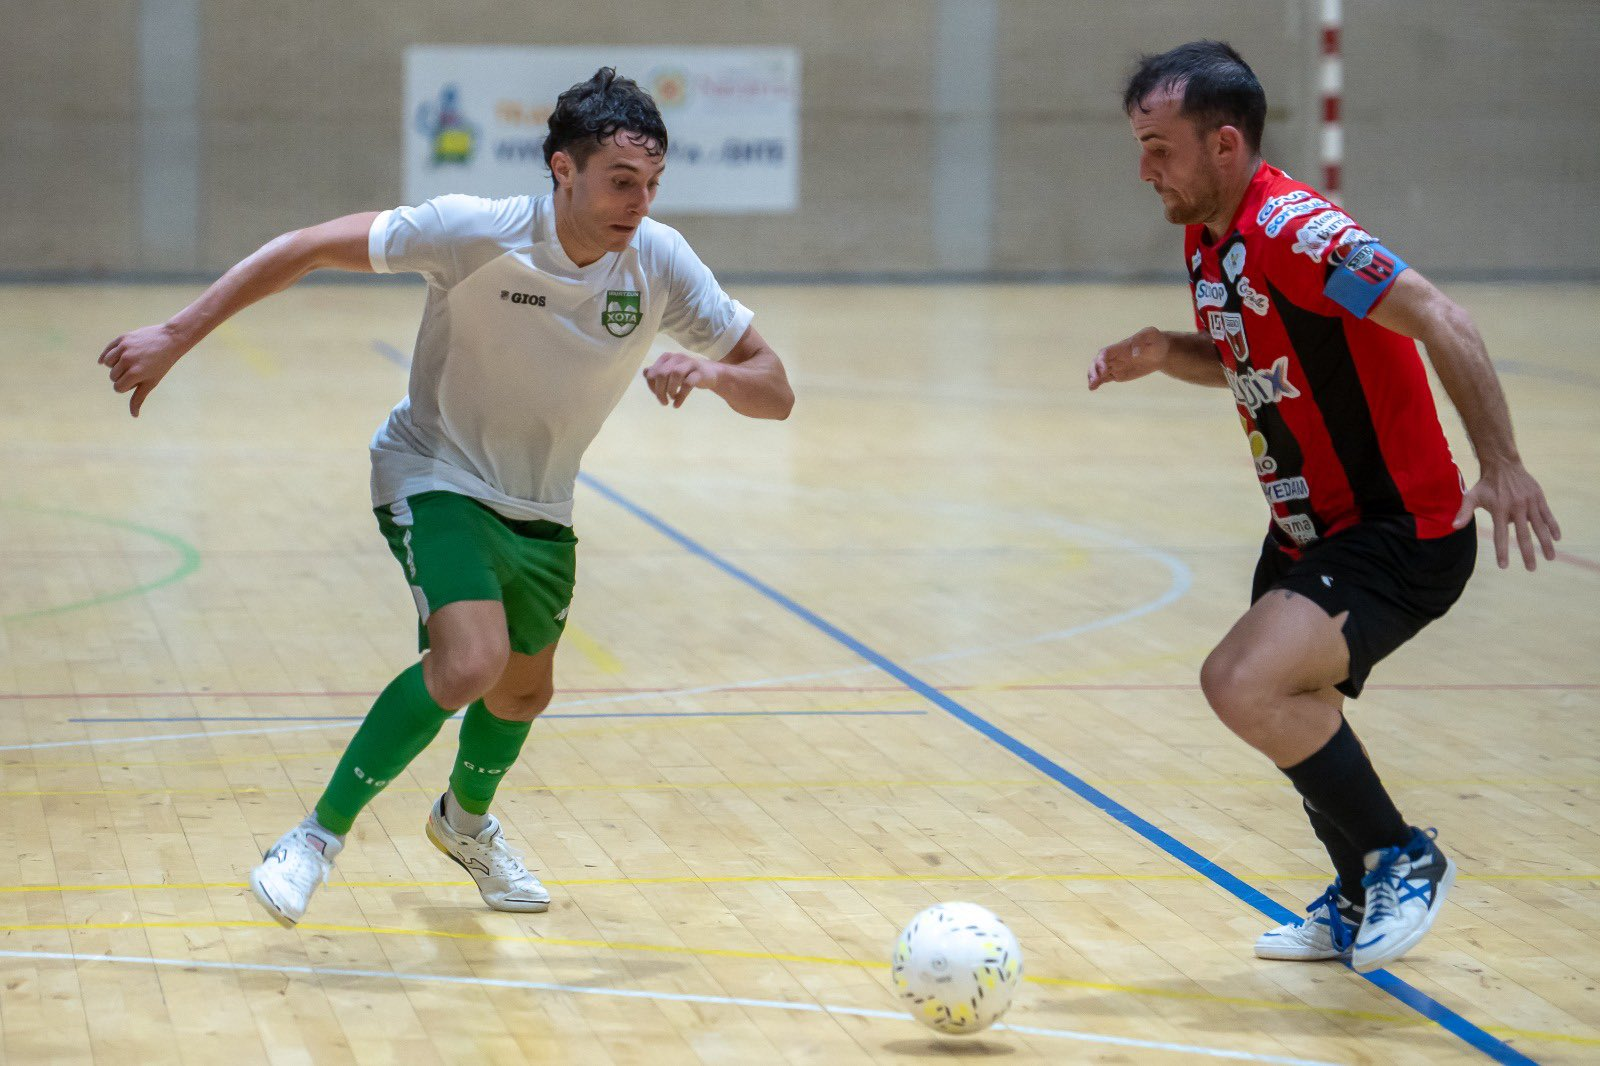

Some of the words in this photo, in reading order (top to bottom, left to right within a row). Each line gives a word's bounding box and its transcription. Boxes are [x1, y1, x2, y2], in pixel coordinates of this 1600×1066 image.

[511, 292, 546, 307] GIOS
[607, 312, 637, 323] XOTA
[354, 766, 388, 787] GIO
